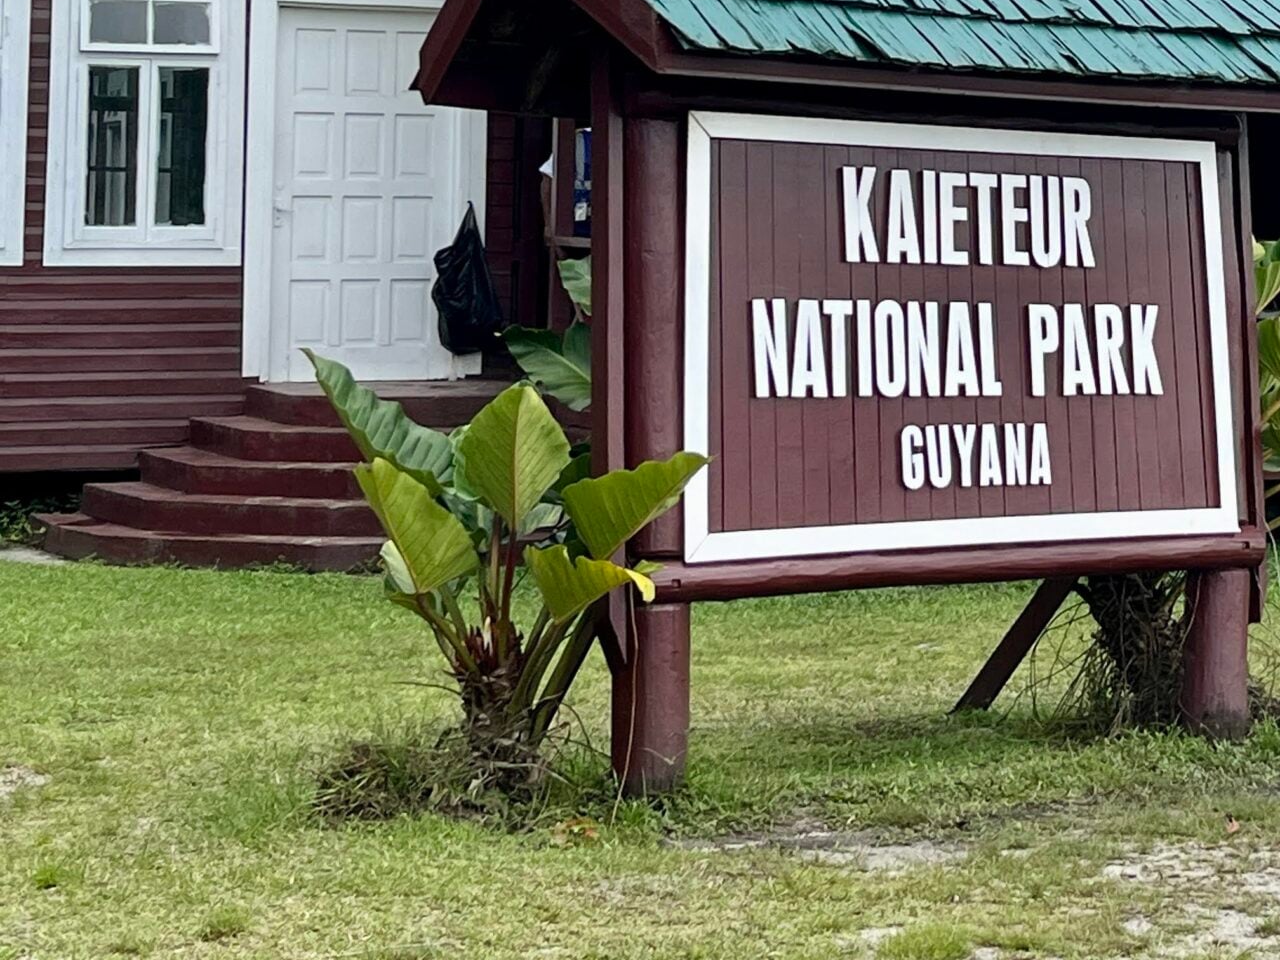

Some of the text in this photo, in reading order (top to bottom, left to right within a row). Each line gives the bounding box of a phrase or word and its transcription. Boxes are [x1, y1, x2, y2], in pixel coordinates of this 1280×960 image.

[842, 165, 1095, 268] KAIETEUR
[751, 298, 1163, 398] NATIONAL PARK
[901, 422, 1052, 490] GUYANA
